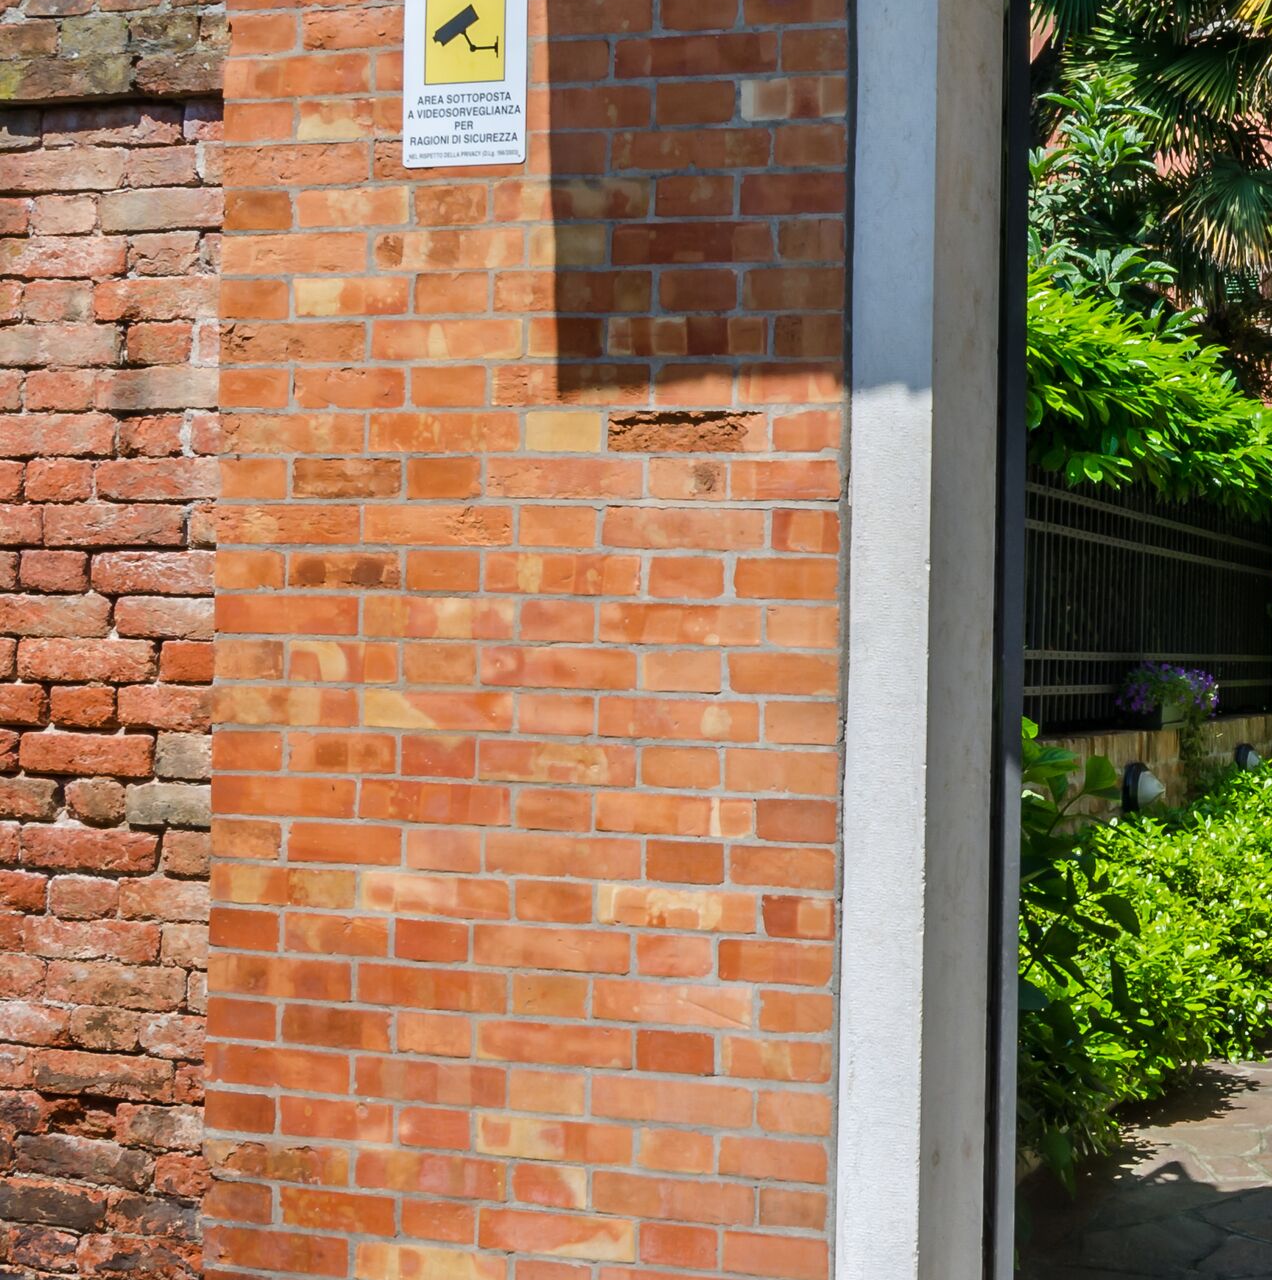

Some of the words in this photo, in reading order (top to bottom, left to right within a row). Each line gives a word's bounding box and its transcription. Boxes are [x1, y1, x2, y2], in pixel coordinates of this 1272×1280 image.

[417, 95, 444, 105] AREA
[446, 91, 512, 104] SOTTOPOSTA
[407, 110, 414, 119] A
[416, 104, 521, 119] VIDEOSORVEGLIANZA
[454, 120, 474, 130] PER
[410, 135, 450, 146] RAGIONI
[451, 134, 461, 145] DI
[463, 132, 518, 144] SICUREZZA
